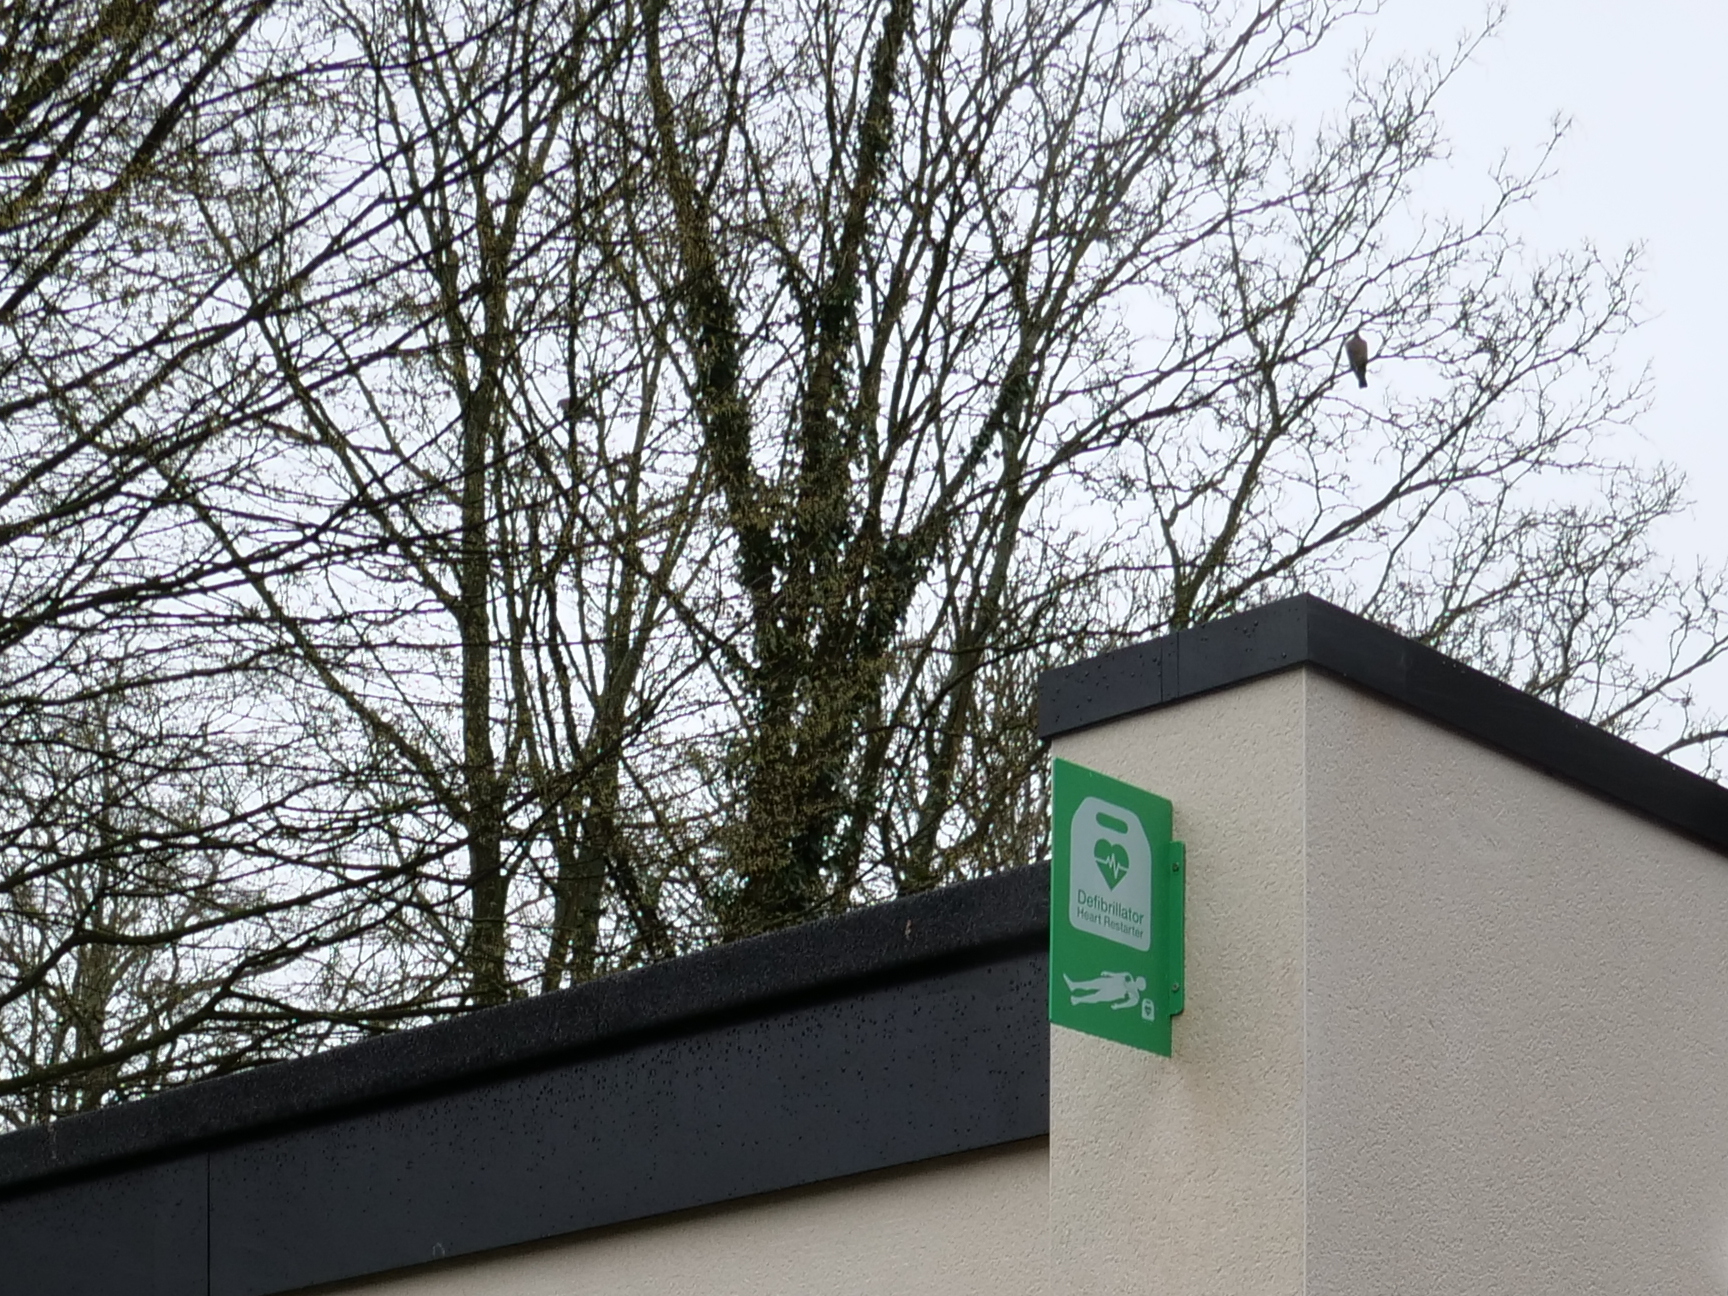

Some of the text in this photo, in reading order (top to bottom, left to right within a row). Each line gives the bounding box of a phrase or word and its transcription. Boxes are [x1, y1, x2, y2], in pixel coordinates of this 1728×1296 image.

[1076, 906, 1144, 939] Heart Restarter
[1077, 888, 1145, 926] Defibrillator
